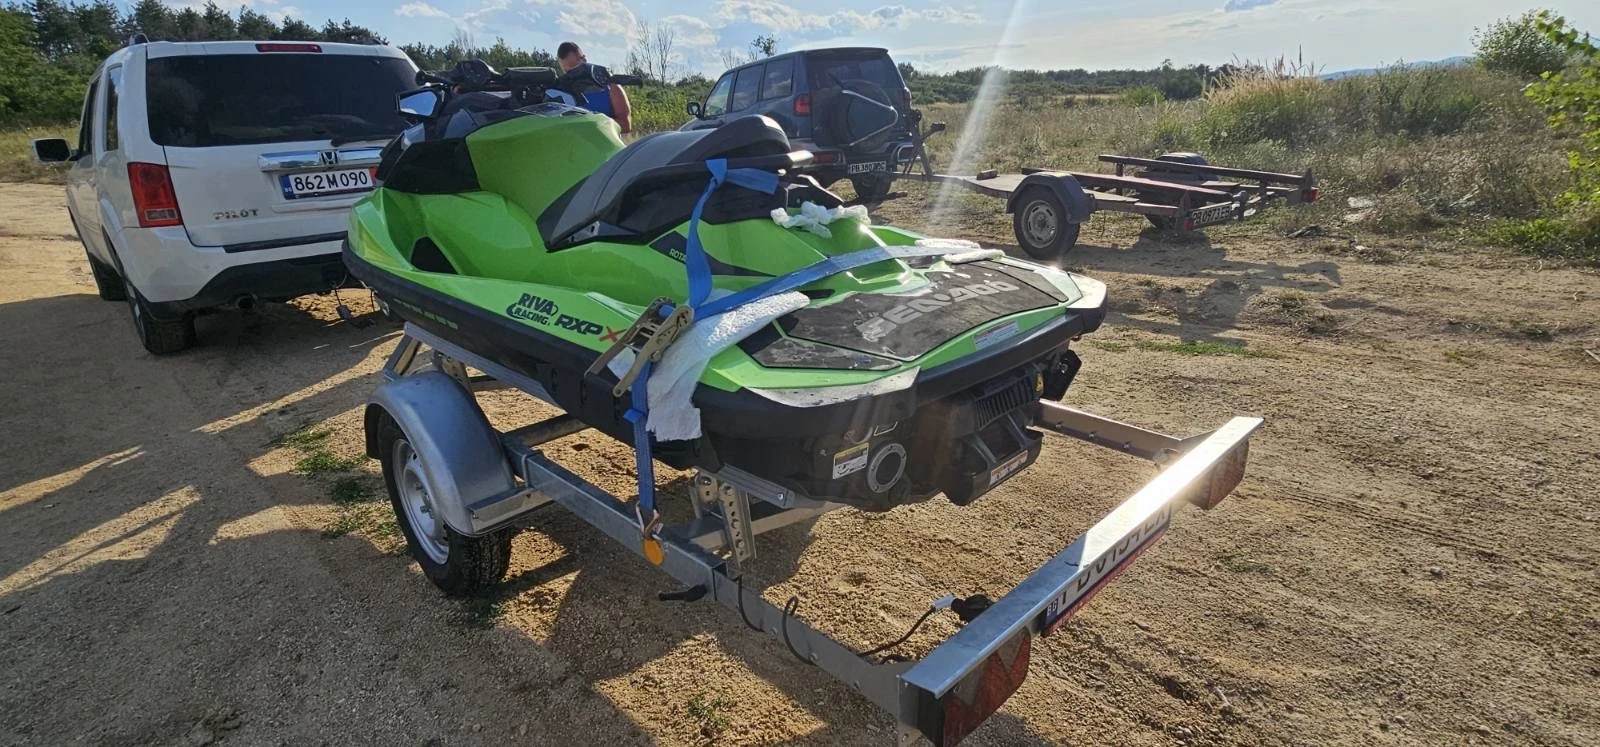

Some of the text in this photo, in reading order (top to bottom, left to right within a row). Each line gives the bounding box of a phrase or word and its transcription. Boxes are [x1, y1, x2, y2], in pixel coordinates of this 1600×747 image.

[294, 171, 368, 191] 862M090
[213, 209, 260, 220] PILOT
[669, 248, 688, 263] ROTA
[518, 293, 554, 315] RIVA
